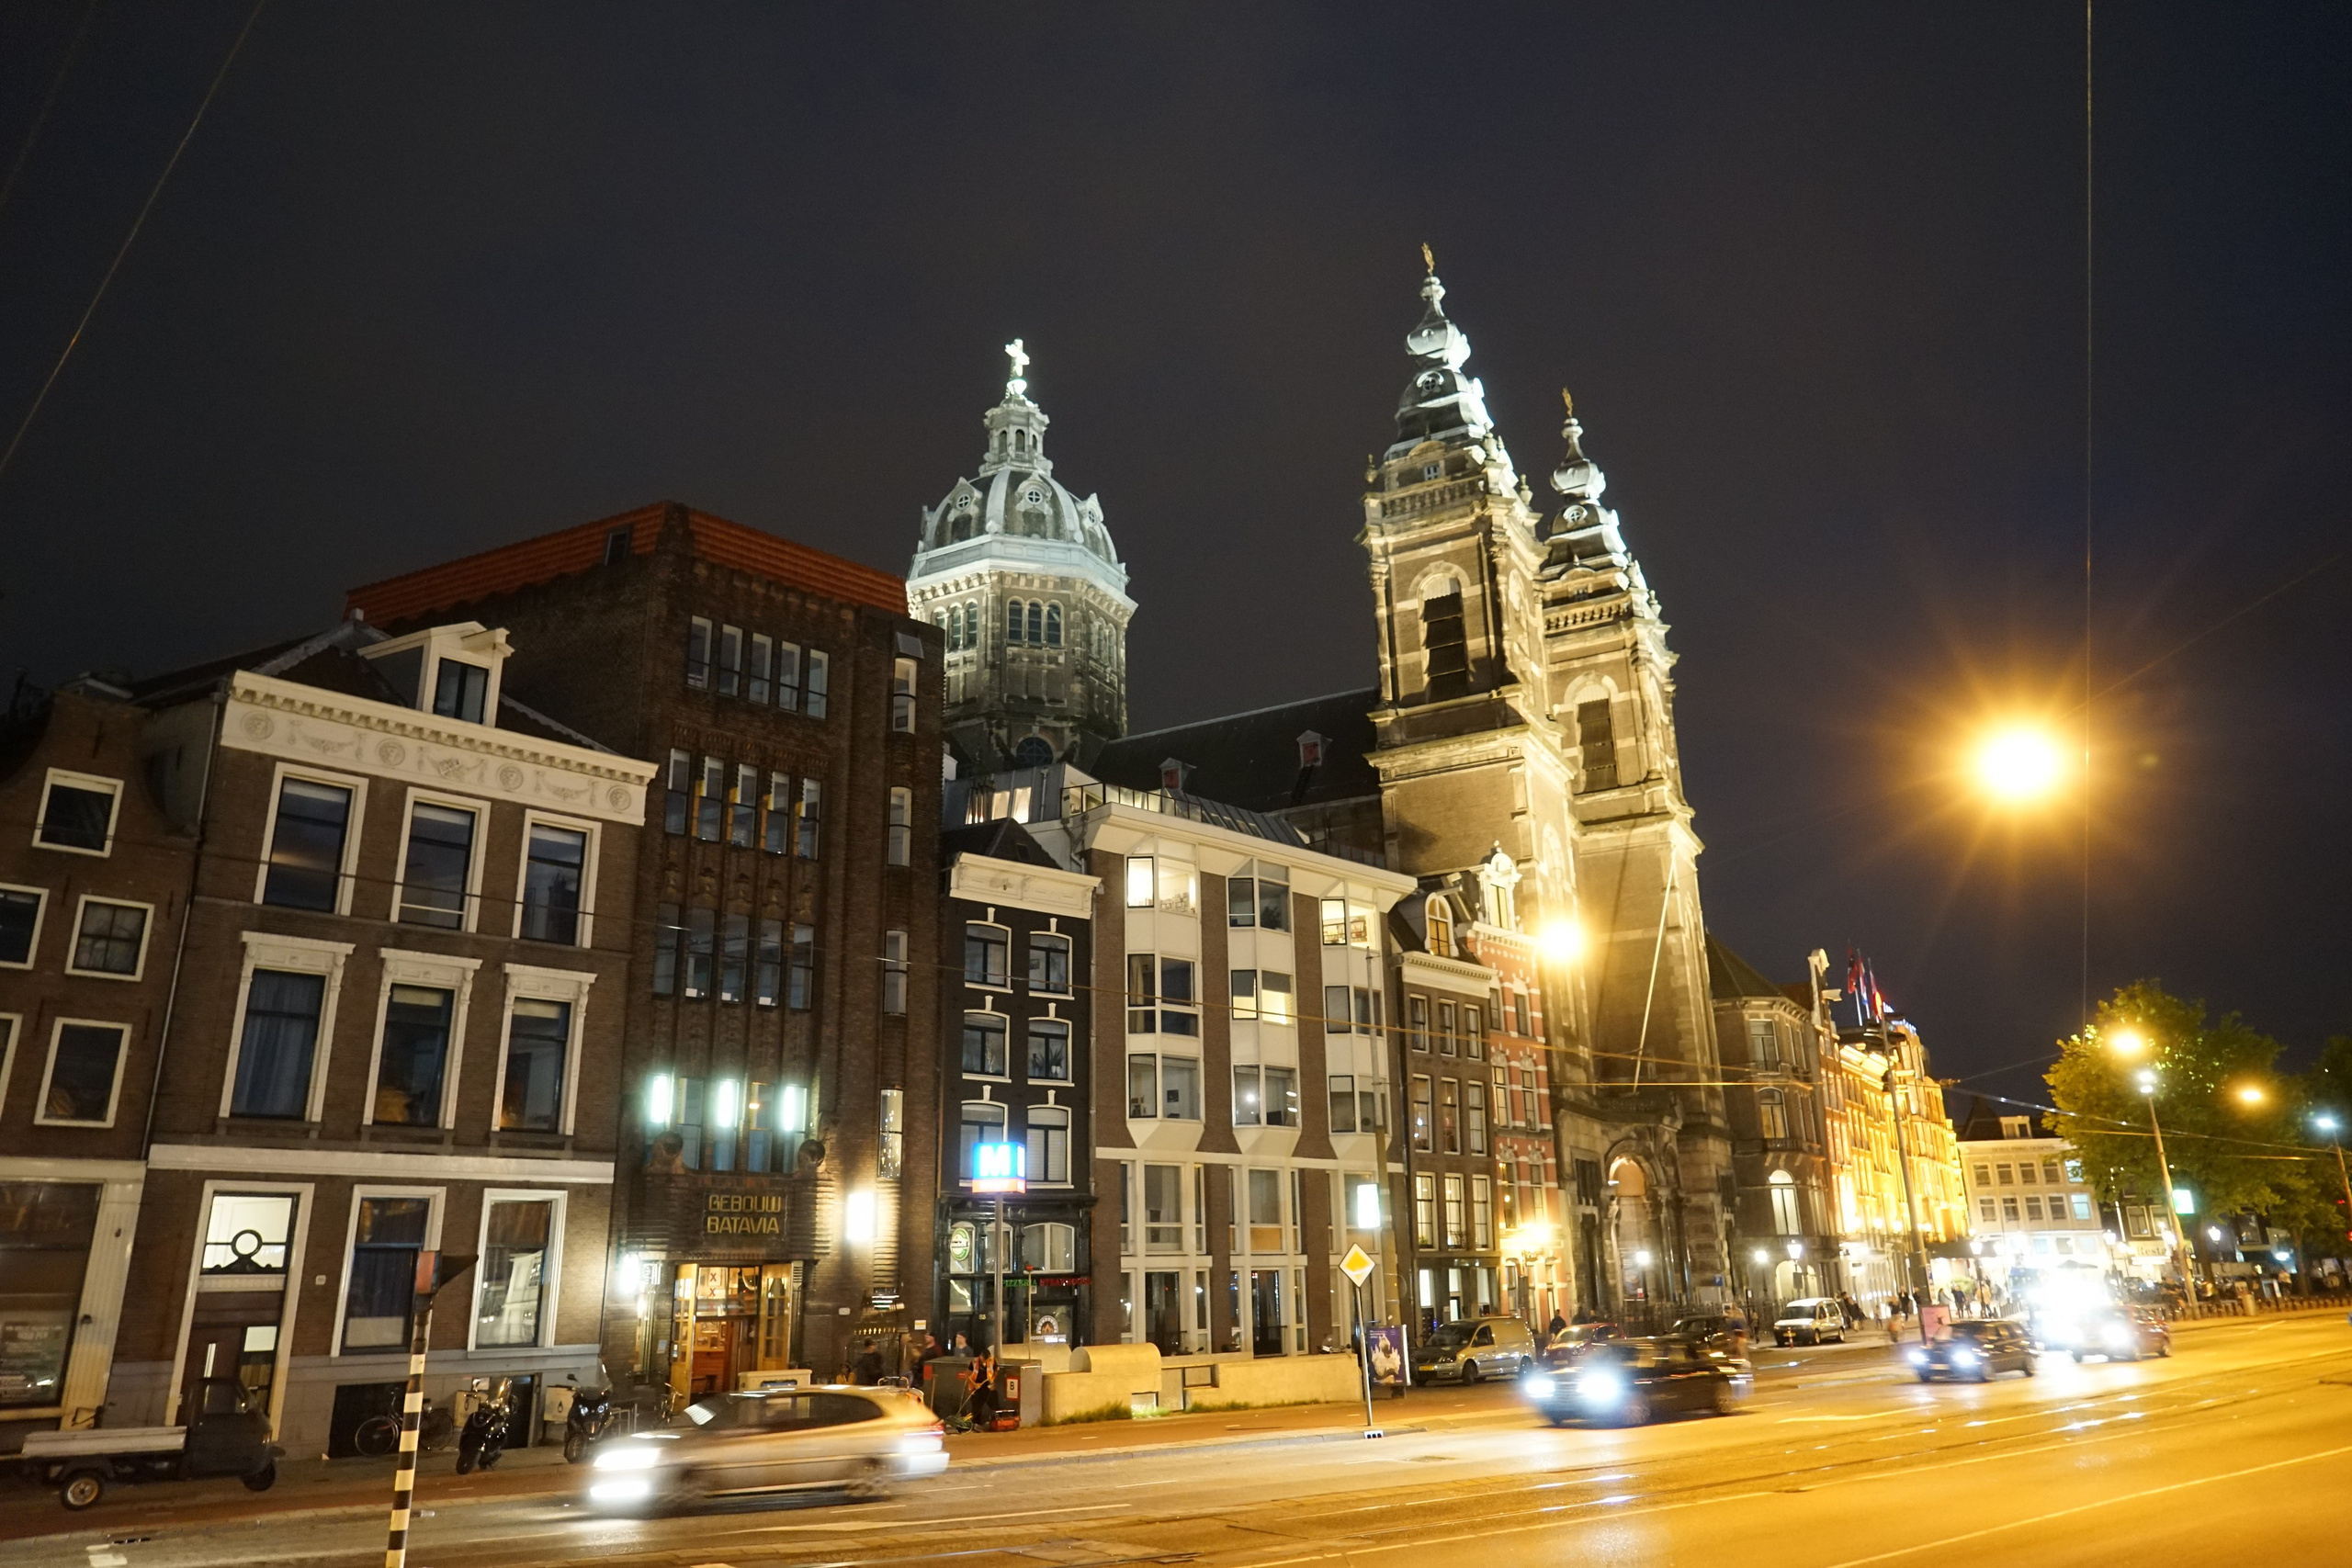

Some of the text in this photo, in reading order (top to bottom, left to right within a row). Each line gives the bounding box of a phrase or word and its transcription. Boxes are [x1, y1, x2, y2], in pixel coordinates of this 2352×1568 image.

[979, 1145, 1010, 1177] M
[708, 1194, 781, 1213] GEBOUW
[707, 1215, 780, 1234] BATAVIA
